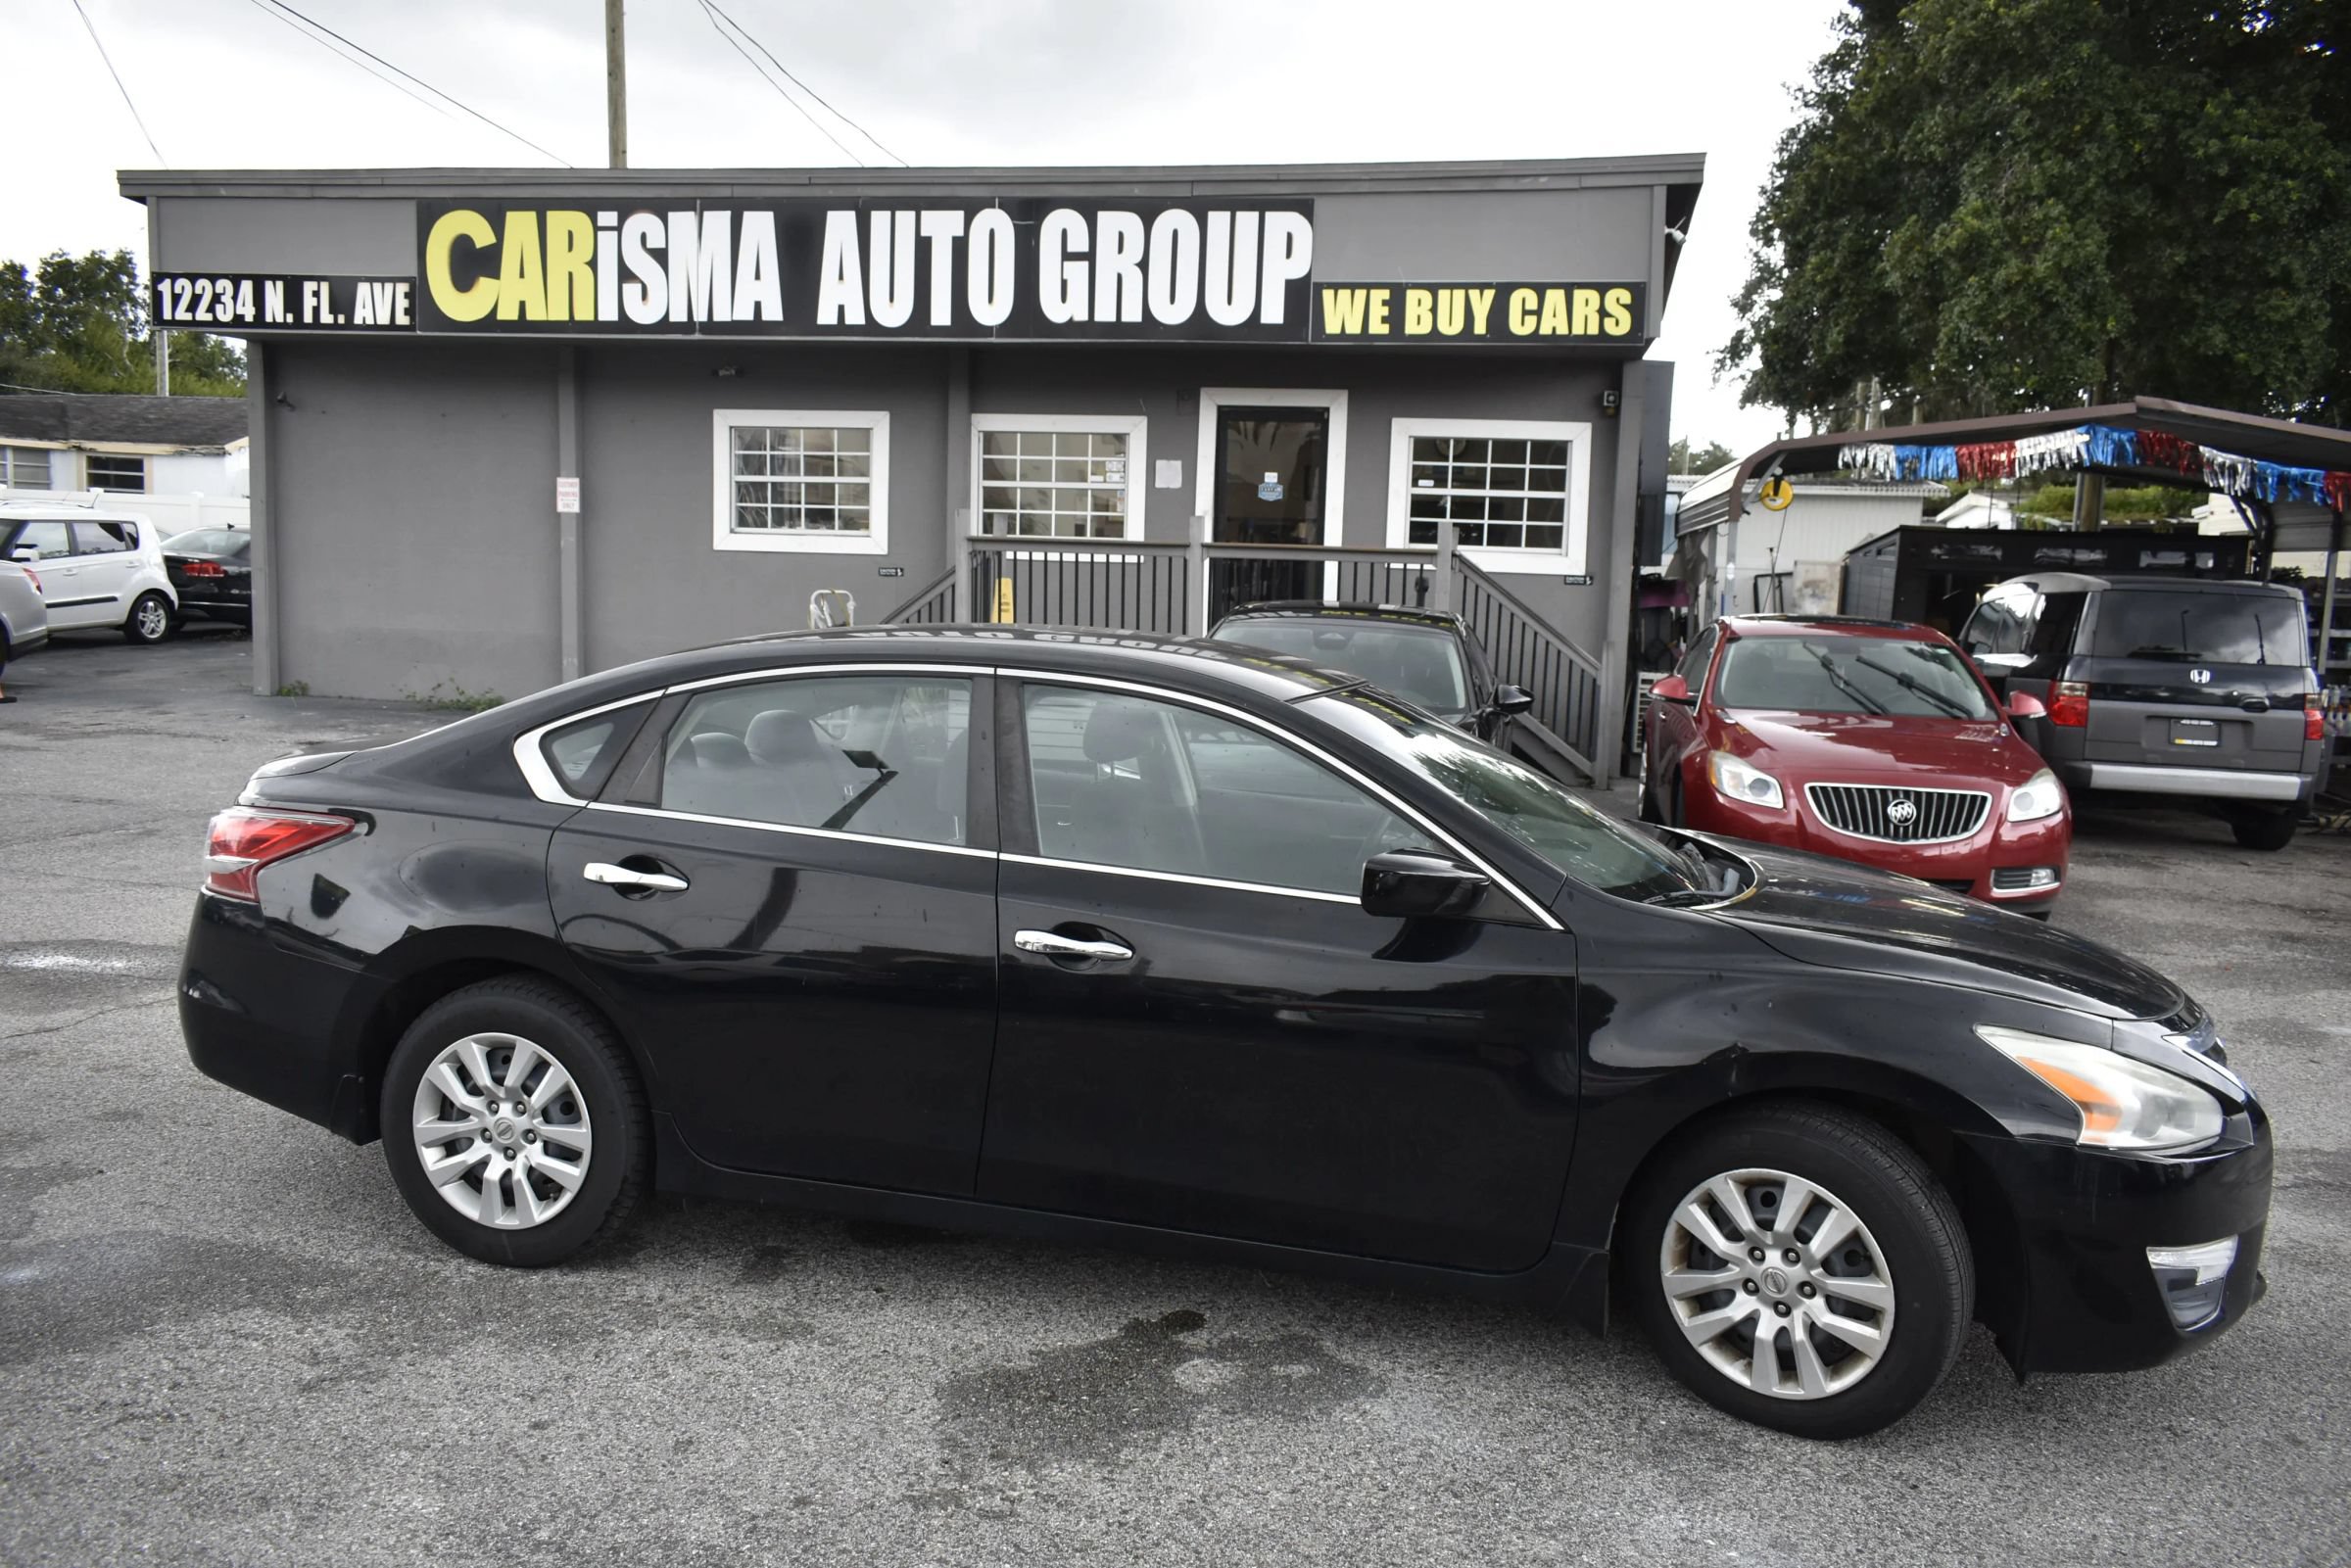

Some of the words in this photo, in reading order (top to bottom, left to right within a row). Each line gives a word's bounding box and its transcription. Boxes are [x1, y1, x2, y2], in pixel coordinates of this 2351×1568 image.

[426, 210, 784, 324] CARiSMA
[817, 208, 1016, 327] AUTO
[1039, 209, 1313, 326] GROUP
[157, 277, 256, 322] 12234
[264, 280, 294, 323] N.
[303, 280, 346, 324] FL.
[354, 282, 410, 325] AVE
[1322, 289, 1390, 334] WE
[1405, 289, 1496, 335] BUY
[1509, 288, 1632, 335] CARS
